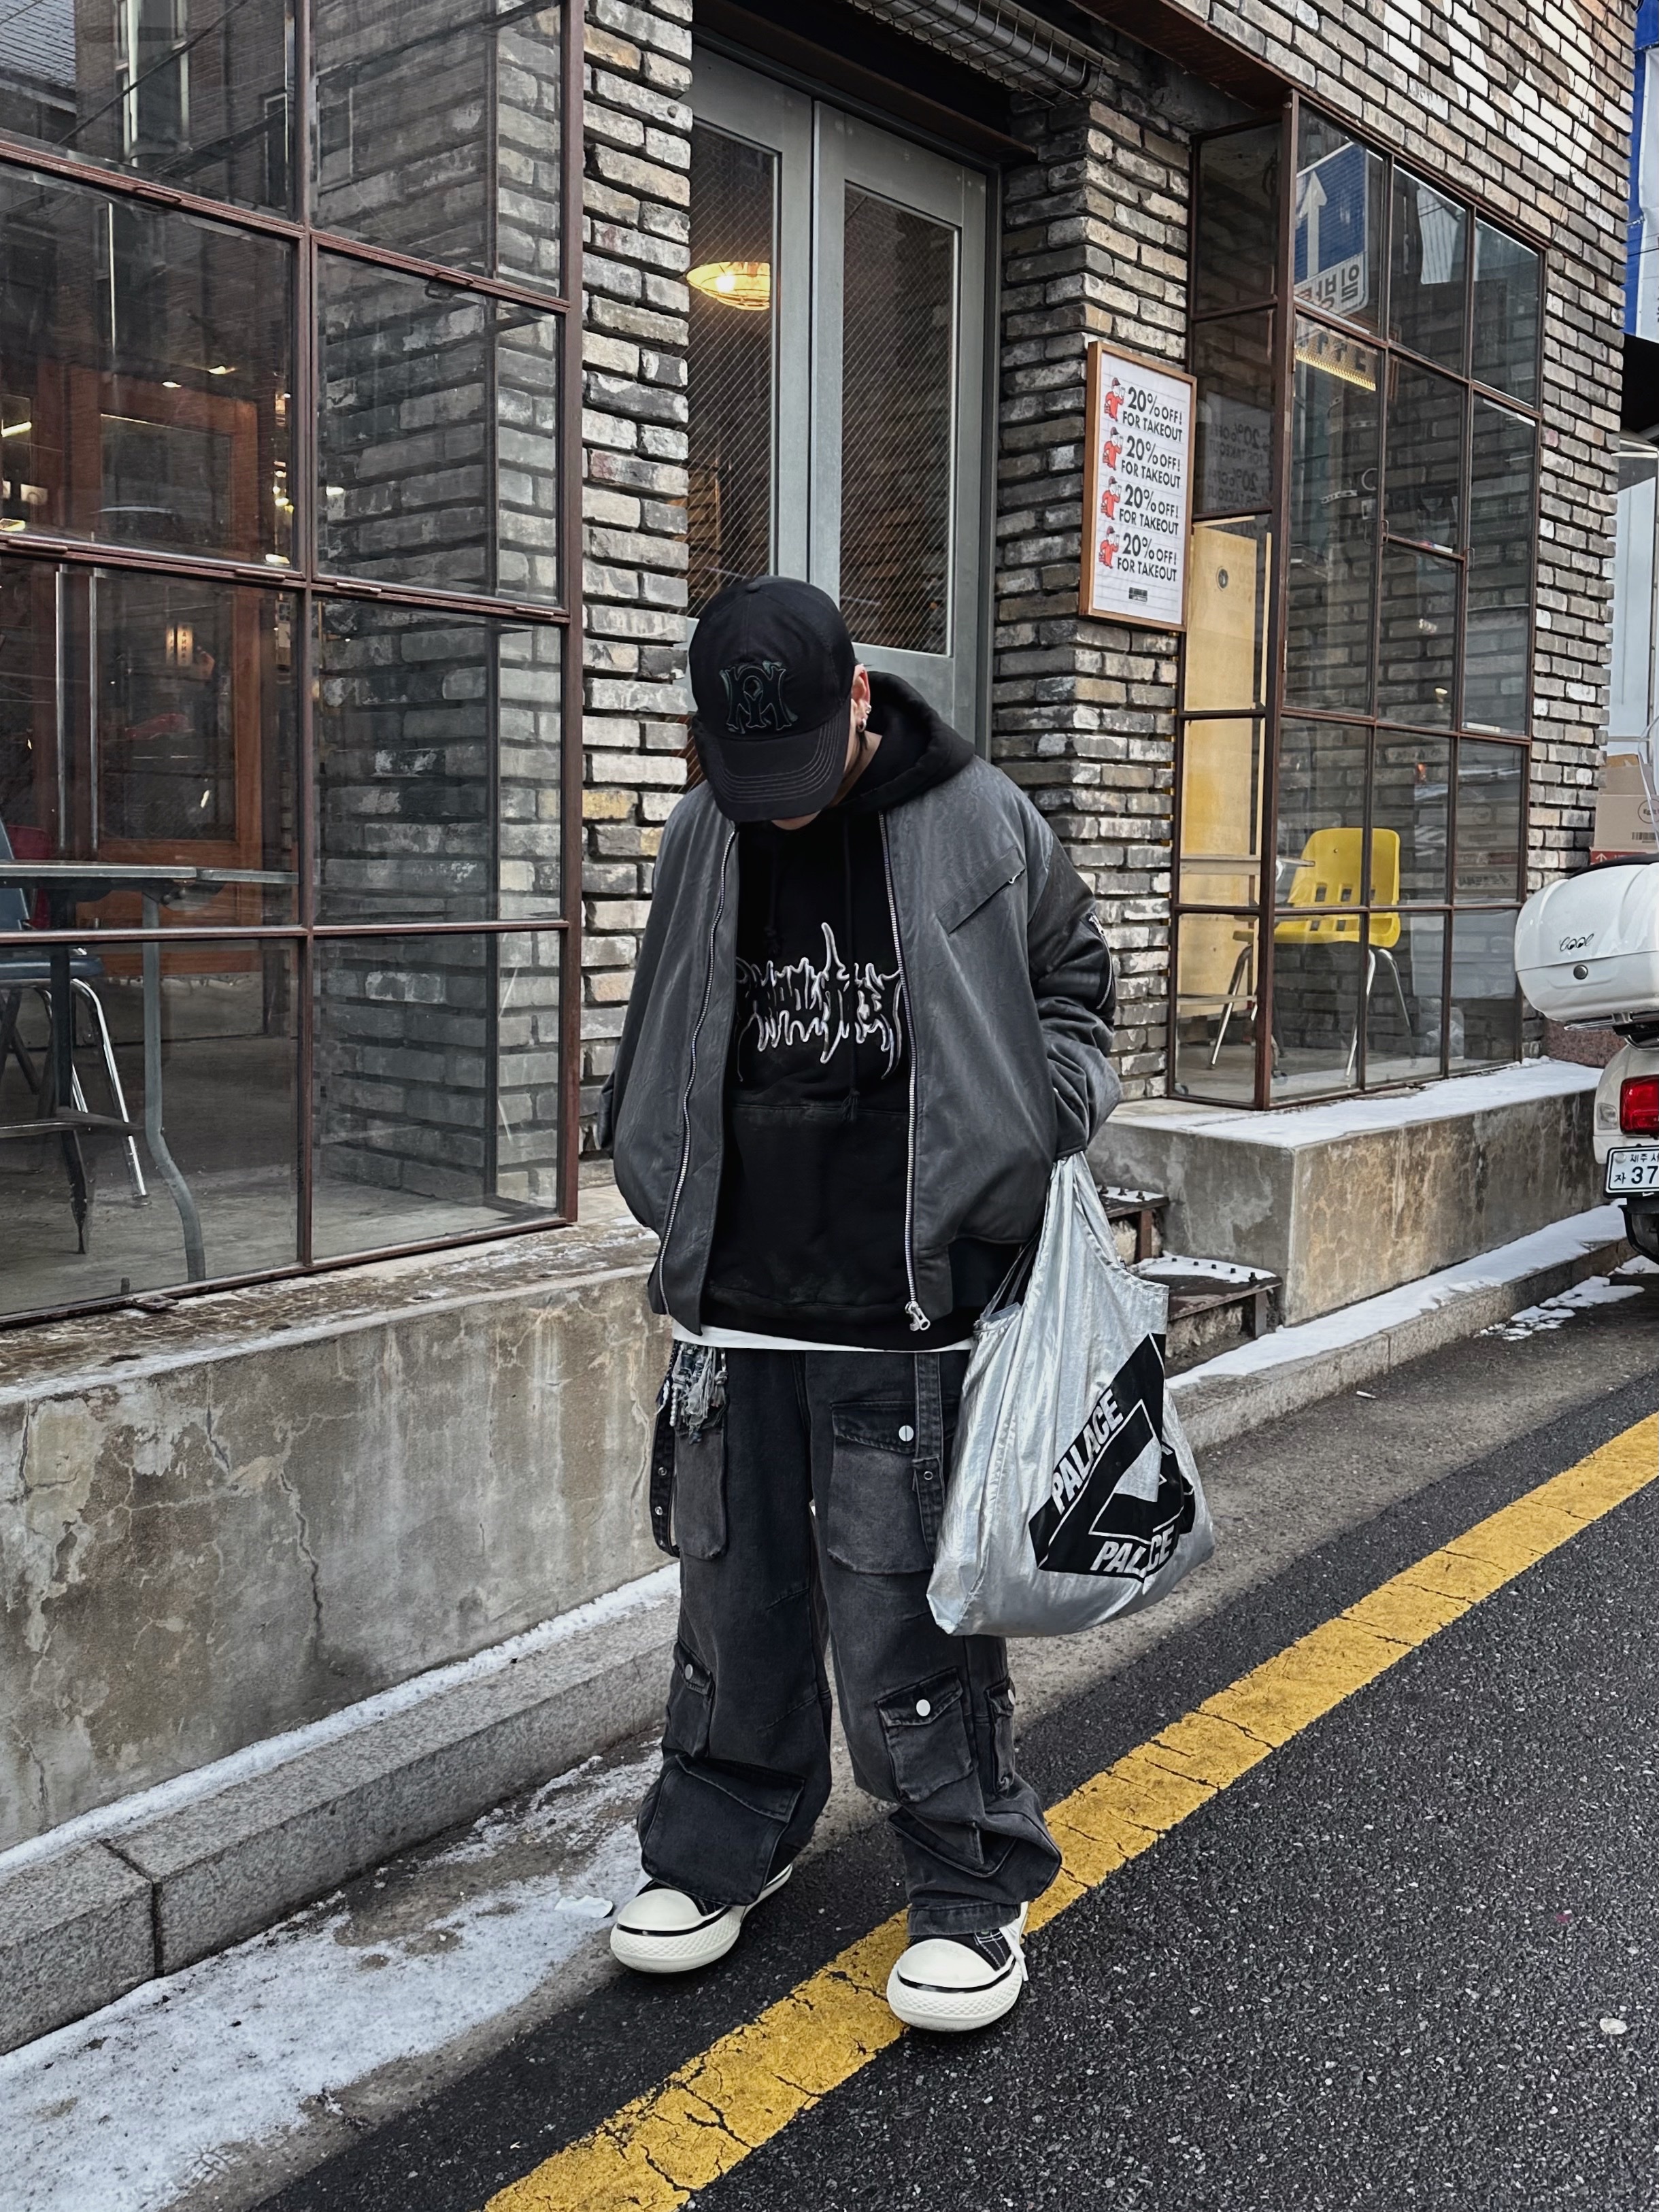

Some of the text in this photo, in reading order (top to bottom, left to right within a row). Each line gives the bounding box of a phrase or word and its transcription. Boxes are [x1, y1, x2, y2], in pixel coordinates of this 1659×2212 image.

[1128, 386, 1182, 425] 20% OFF!
[1122, 411, 1182, 442] FOR TAKEOUT
[1126, 435, 1180, 472] 20% OFF!
[1121, 459, 1181, 489] FOR TAKEOUT
[1124, 484, 1178, 519] 20% OFF!
[1119, 508, 1179, 535] FOR TAKEOUT
[1122, 532, 1177, 565] 20% OFF!
[1118, 557, 1177, 582] FOR TAKEOUT
[1630, 1153, 1648, 1163] 제주
[1613, 1165, 1659, 1185] 자 37
[1051, 1388, 1124, 1515] PALACE
[1090, 1524, 1175, 1579] PALCE
